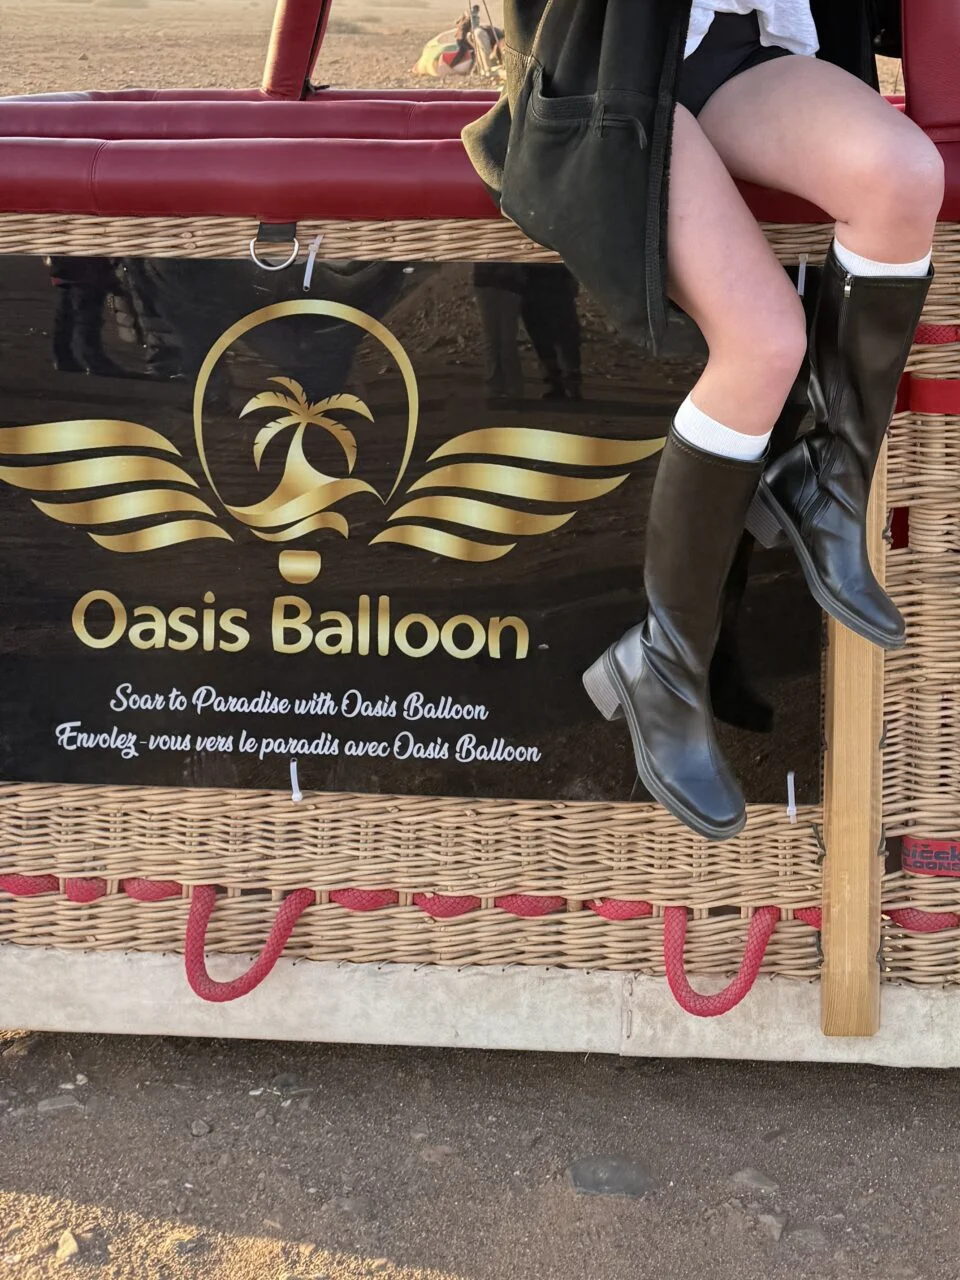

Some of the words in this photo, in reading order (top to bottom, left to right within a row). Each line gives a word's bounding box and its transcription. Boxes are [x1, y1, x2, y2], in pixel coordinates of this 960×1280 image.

[71, 589, 250, 653] Oasis
[271, 594, 530, 660] Balloon
[110, 683, 165, 712] Soar
[168, 687, 187, 711] to
[191, 685, 291, 715] Paradise
[294, 691, 338, 715] with
[341, 689, 397, 718] Oasis
[403, 691, 489, 720] Balloon
[55, 721, 191, 760] Envolez-vous
[195, 734, 233, 753] vers
[238, 729, 258, 753] le
[258, 732, 339, 760] paradis
[344, 740, 390, 757] avec
[393, 731, 449, 760] Oasis
[455, 733, 542, 763] Balloon
